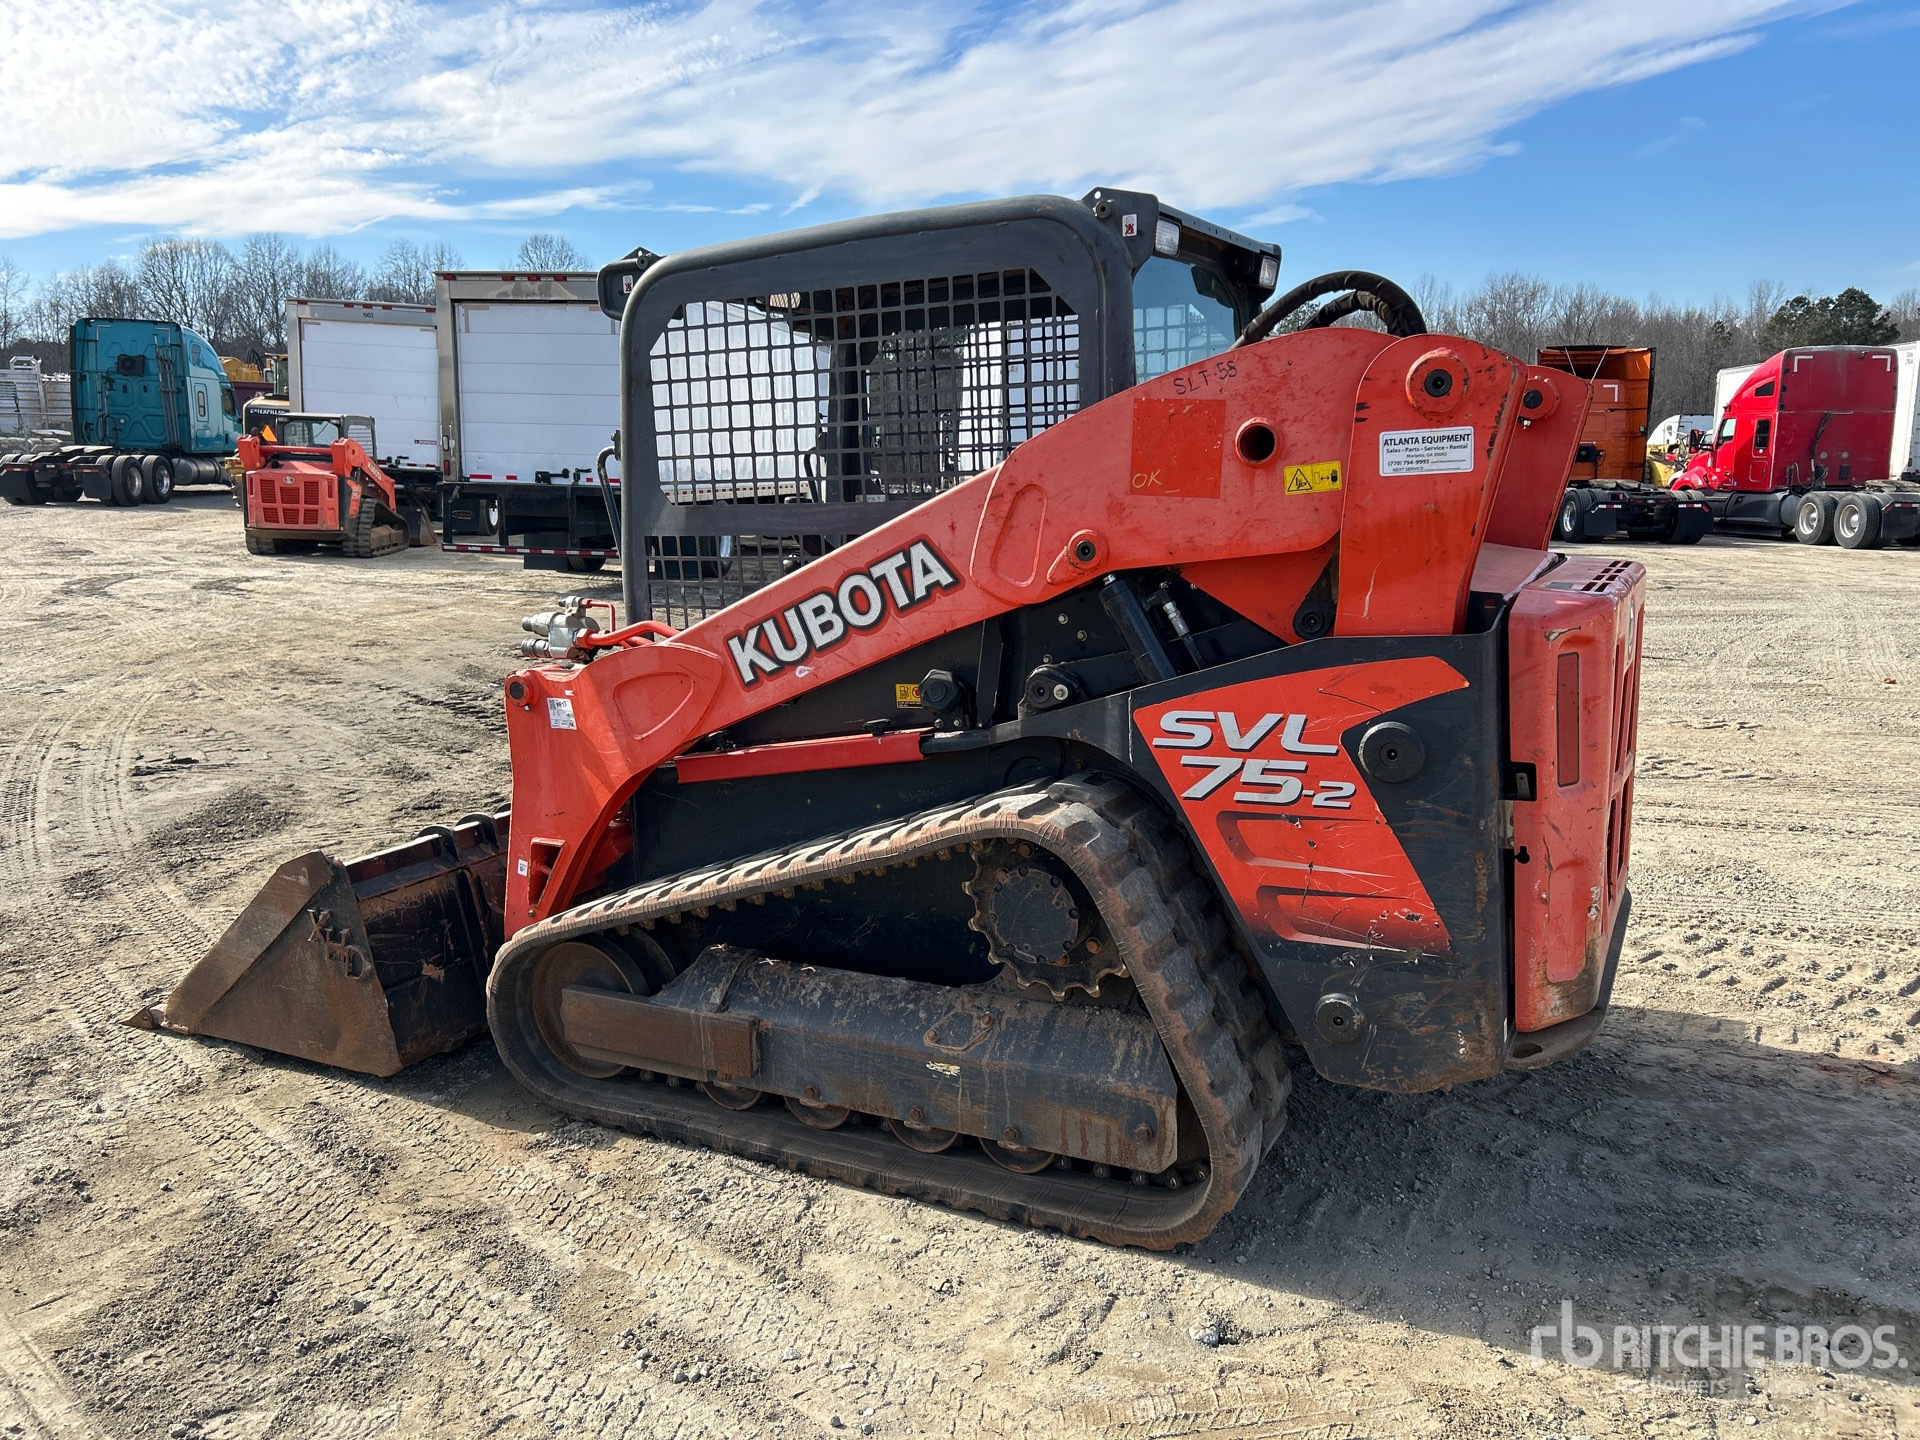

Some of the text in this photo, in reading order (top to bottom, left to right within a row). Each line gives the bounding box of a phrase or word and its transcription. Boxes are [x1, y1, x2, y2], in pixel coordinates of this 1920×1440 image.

[1383, 433, 1471, 447] ATLANTA EQUIPMENT
[727, 541, 956, 685] KUBOTA
[1151, 710, 1339, 756] SVL
[1180, 755, 1356, 808] 75-2
